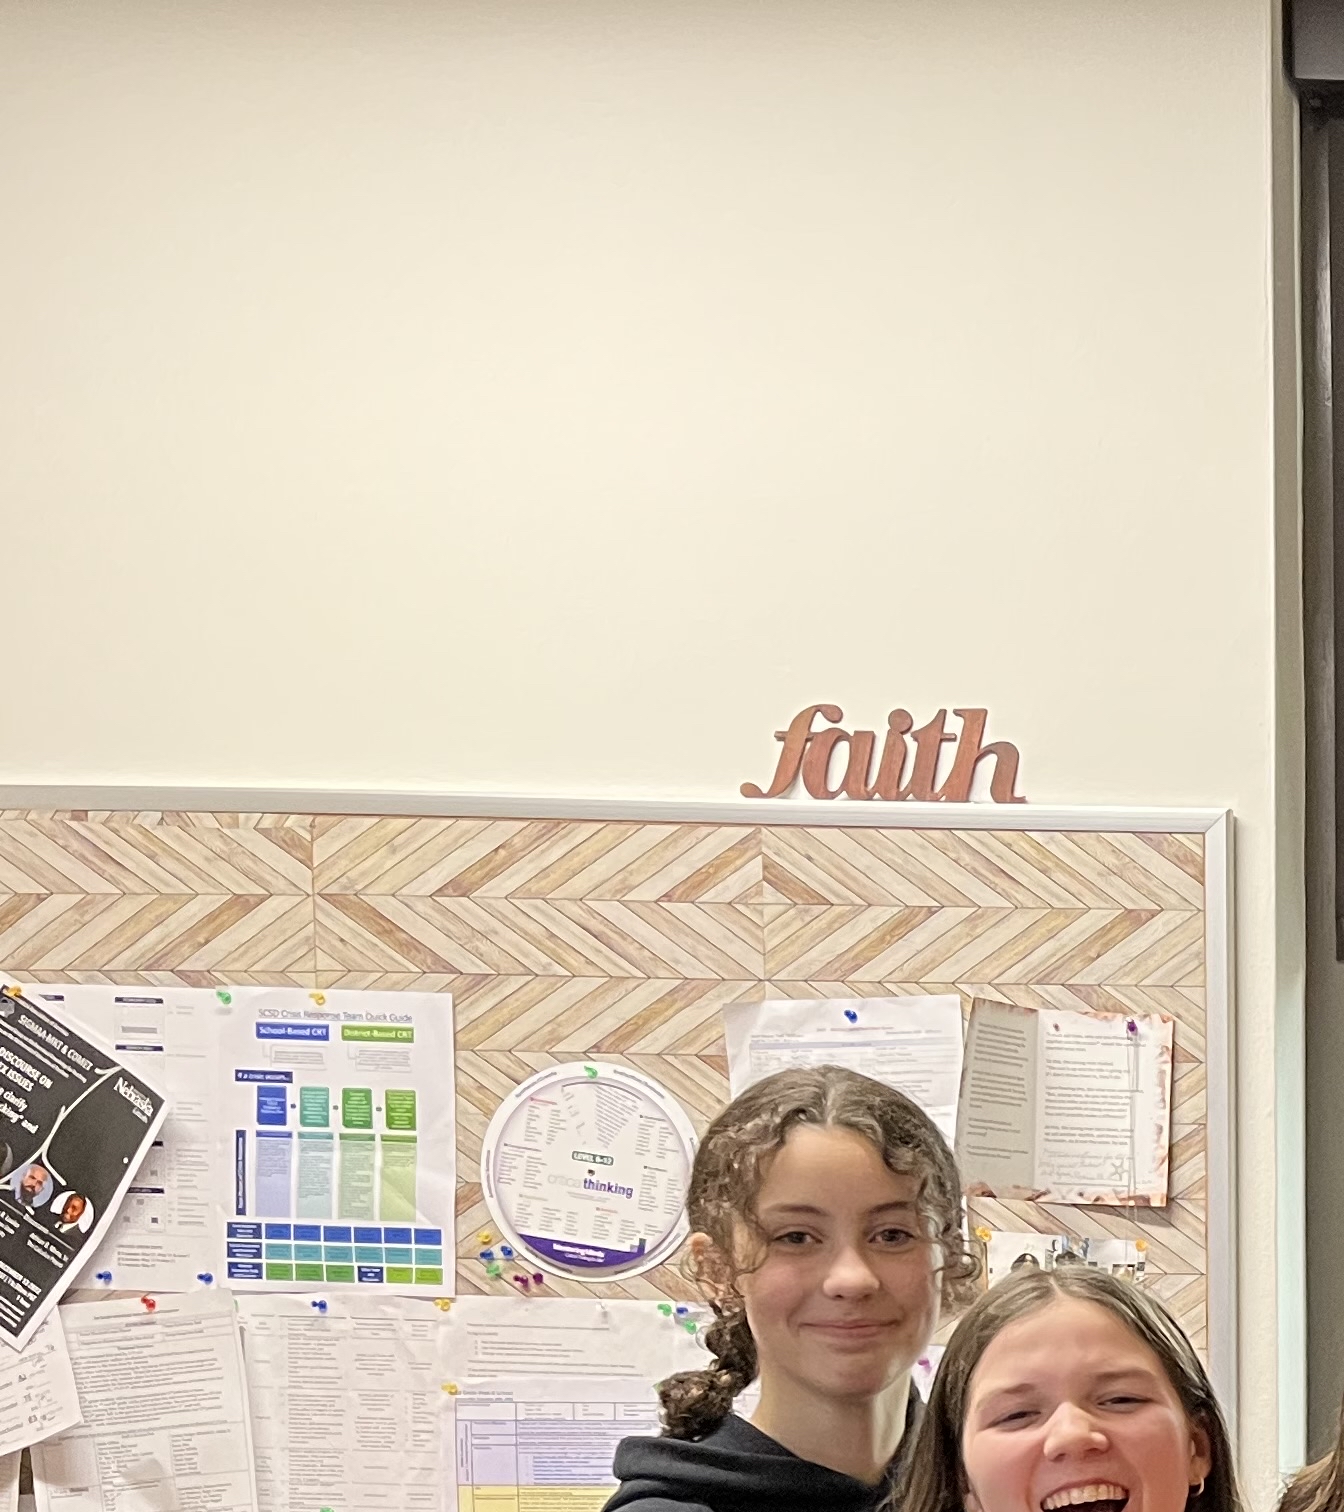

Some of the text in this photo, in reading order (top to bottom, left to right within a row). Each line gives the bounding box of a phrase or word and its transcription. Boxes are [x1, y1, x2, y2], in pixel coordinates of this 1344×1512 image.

[740, 703, 1028, 804] faith
[304, 1011, 341, 1021] Response
[342, 1012, 363, 1021] Team
[365, 1011, 387, 1022] Quick
[389, 1013, 413, 1023] Guide
[259, 1026, 310, 1036] School-Based
[113, 1077, 154, 1117] Nebraska
[583, 1178, 633, 1199] thinking
